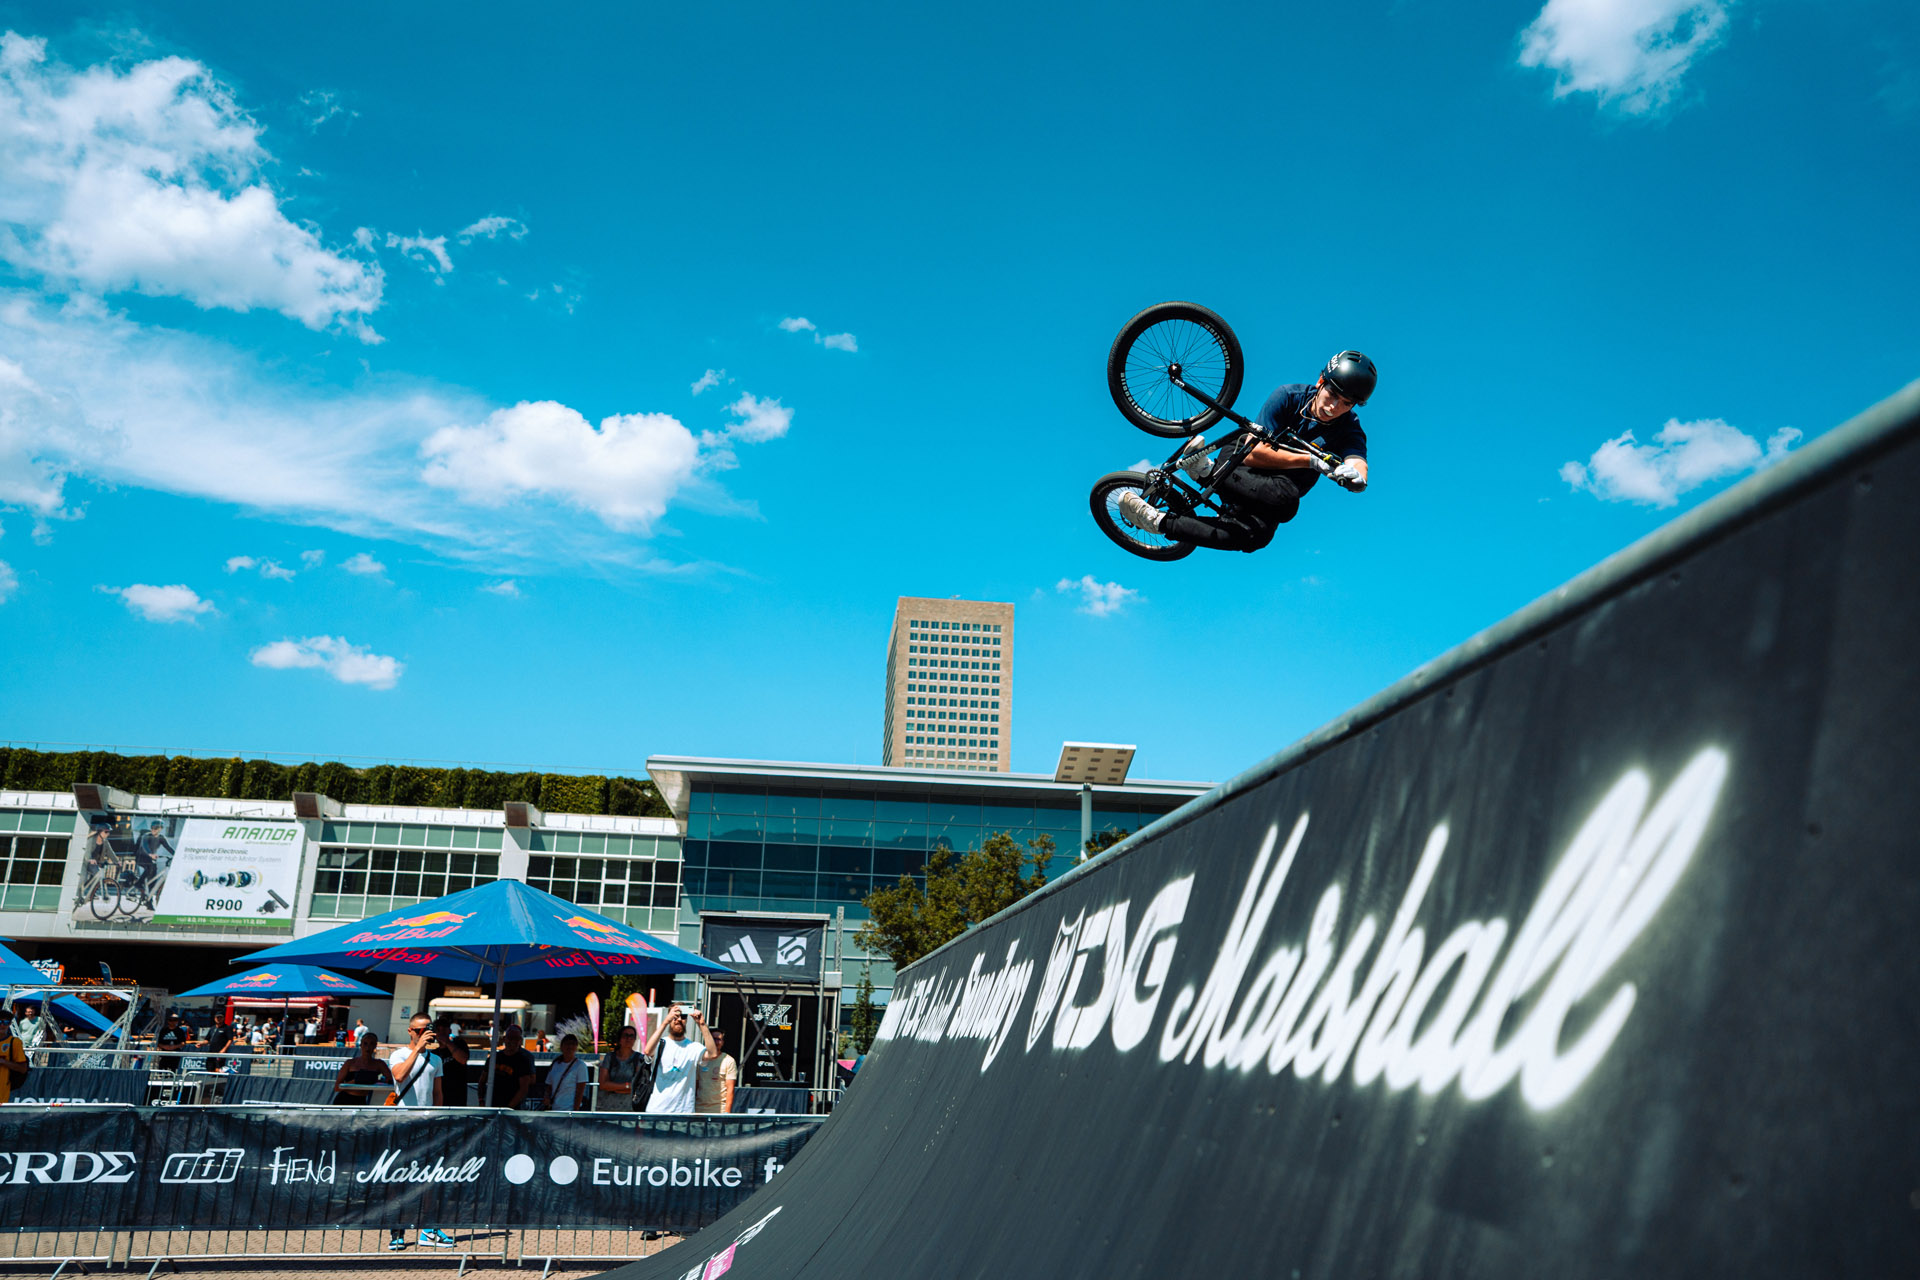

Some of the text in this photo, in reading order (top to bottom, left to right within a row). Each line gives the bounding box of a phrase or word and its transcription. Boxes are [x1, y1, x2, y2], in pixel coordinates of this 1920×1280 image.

[222, 826, 298, 841] ANANDA
[205, 898, 243, 911] R900
[342, 925, 462, 944] Red Bull
[1160, 746, 1729, 1111] Marshall
[356, 1149, 487, 1183] Marshall
[592, 1157, 743, 1187] Eurobike
